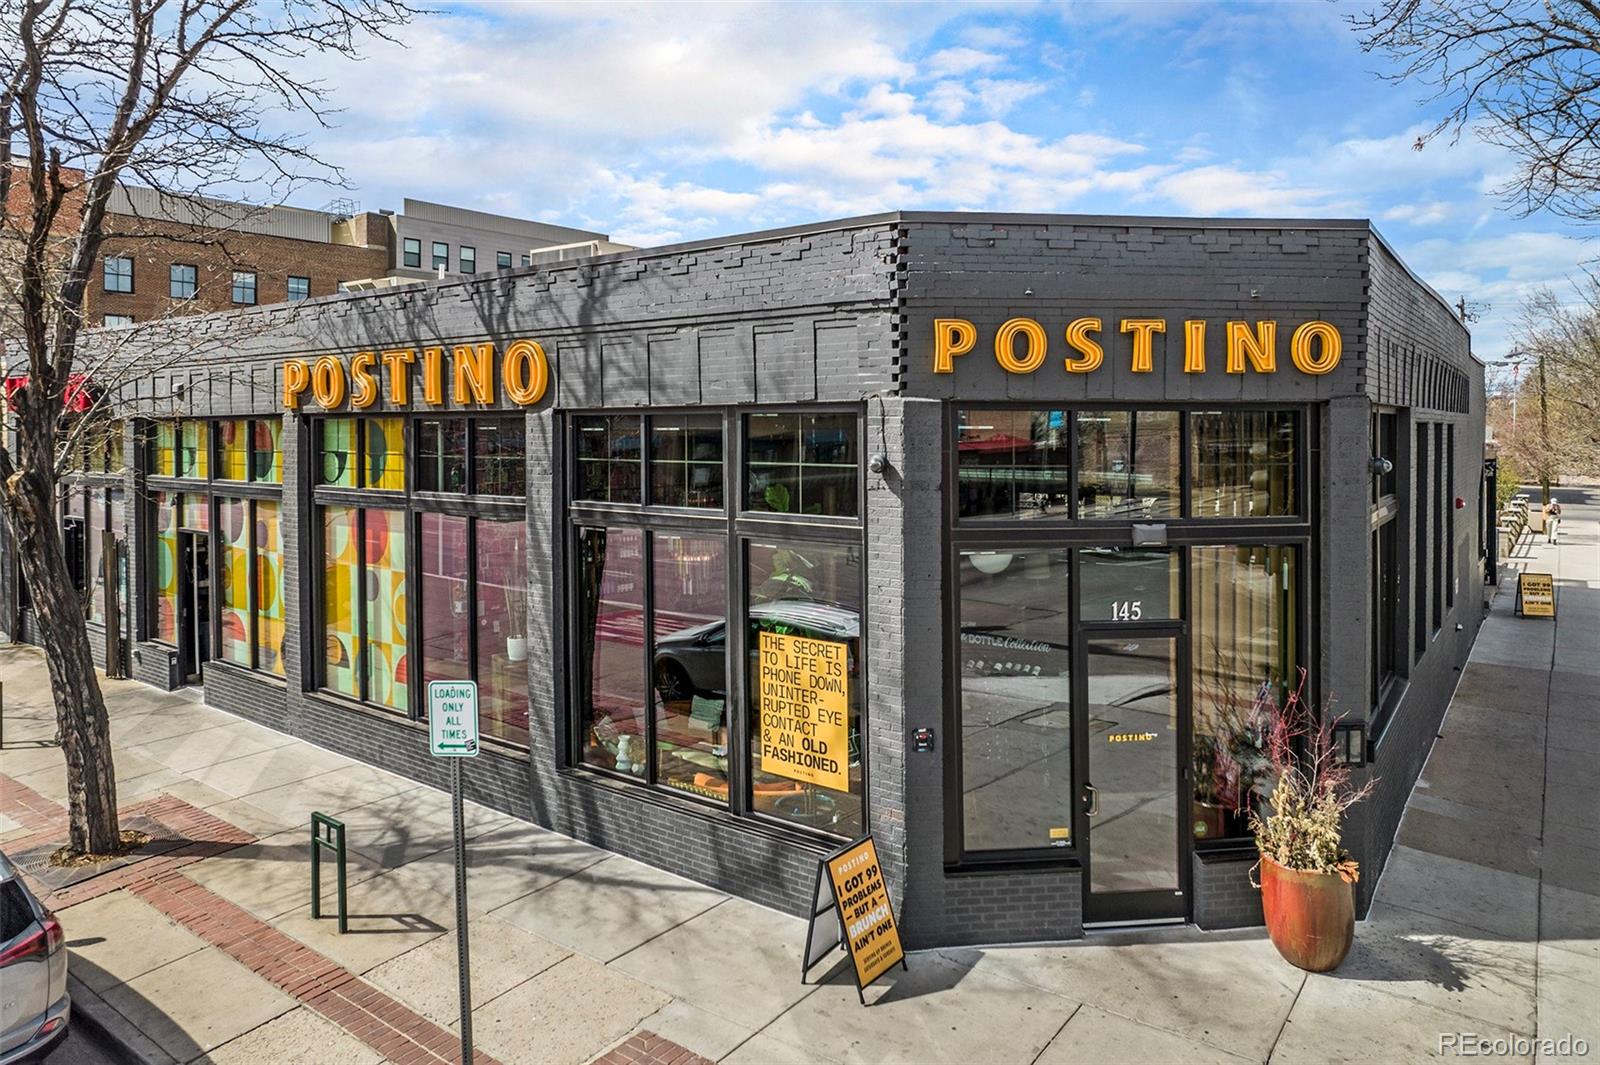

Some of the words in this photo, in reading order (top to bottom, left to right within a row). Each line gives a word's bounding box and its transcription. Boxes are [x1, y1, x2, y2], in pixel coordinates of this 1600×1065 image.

[934, 317, 1342, 375] POSTINO
[283, 339, 548, 409] POSTINO
[1111, 601, 1141, 621] 145
[763, 635, 785, 651] THE
[793, 639, 841, 660] SECRET
[763, 650, 778, 666] TO
[786, 654, 817, 673] LIFE
[826, 661, 842, 677] IS
[434, 688, 471, 699] LOADING
[763, 666, 801, 686] PHONE
[810, 675, 846, 697] DOWN,
[763, 682, 824, 705] UNINTER-
[442, 702, 464, 712] ONLY
[763, 697, 810, 719] RUPTED
[818, 708, 843, 726] EYE
[446, 716, 461, 726] ALL
[763, 713, 818, 737] CONTACT
[441, 730, 467, 739] TIMES
[763, 729, 772, 742] &
[779, 732, 794, 748] AN
[802, 737, 828, 755] OLD
[1108, 732, 1152, 742] POSTINO
[763, 744, 842, 776] FASHIONED.
[838, 851, 869, 875] POSTINO
[838, 885, 843, 897] I
[844, 872, 864, 893] GOT
[866, 865, 878, 881] 99
[842, 879, 882, 911] PROBLEMS
[854, 901, 870, 918] BUT
[871, 897, 878, 908] A
[849, 904, 889, 938] BRUNCH
[854, 931, 876, 952] AIN'T
[876, 918, 893, 937] ONE
